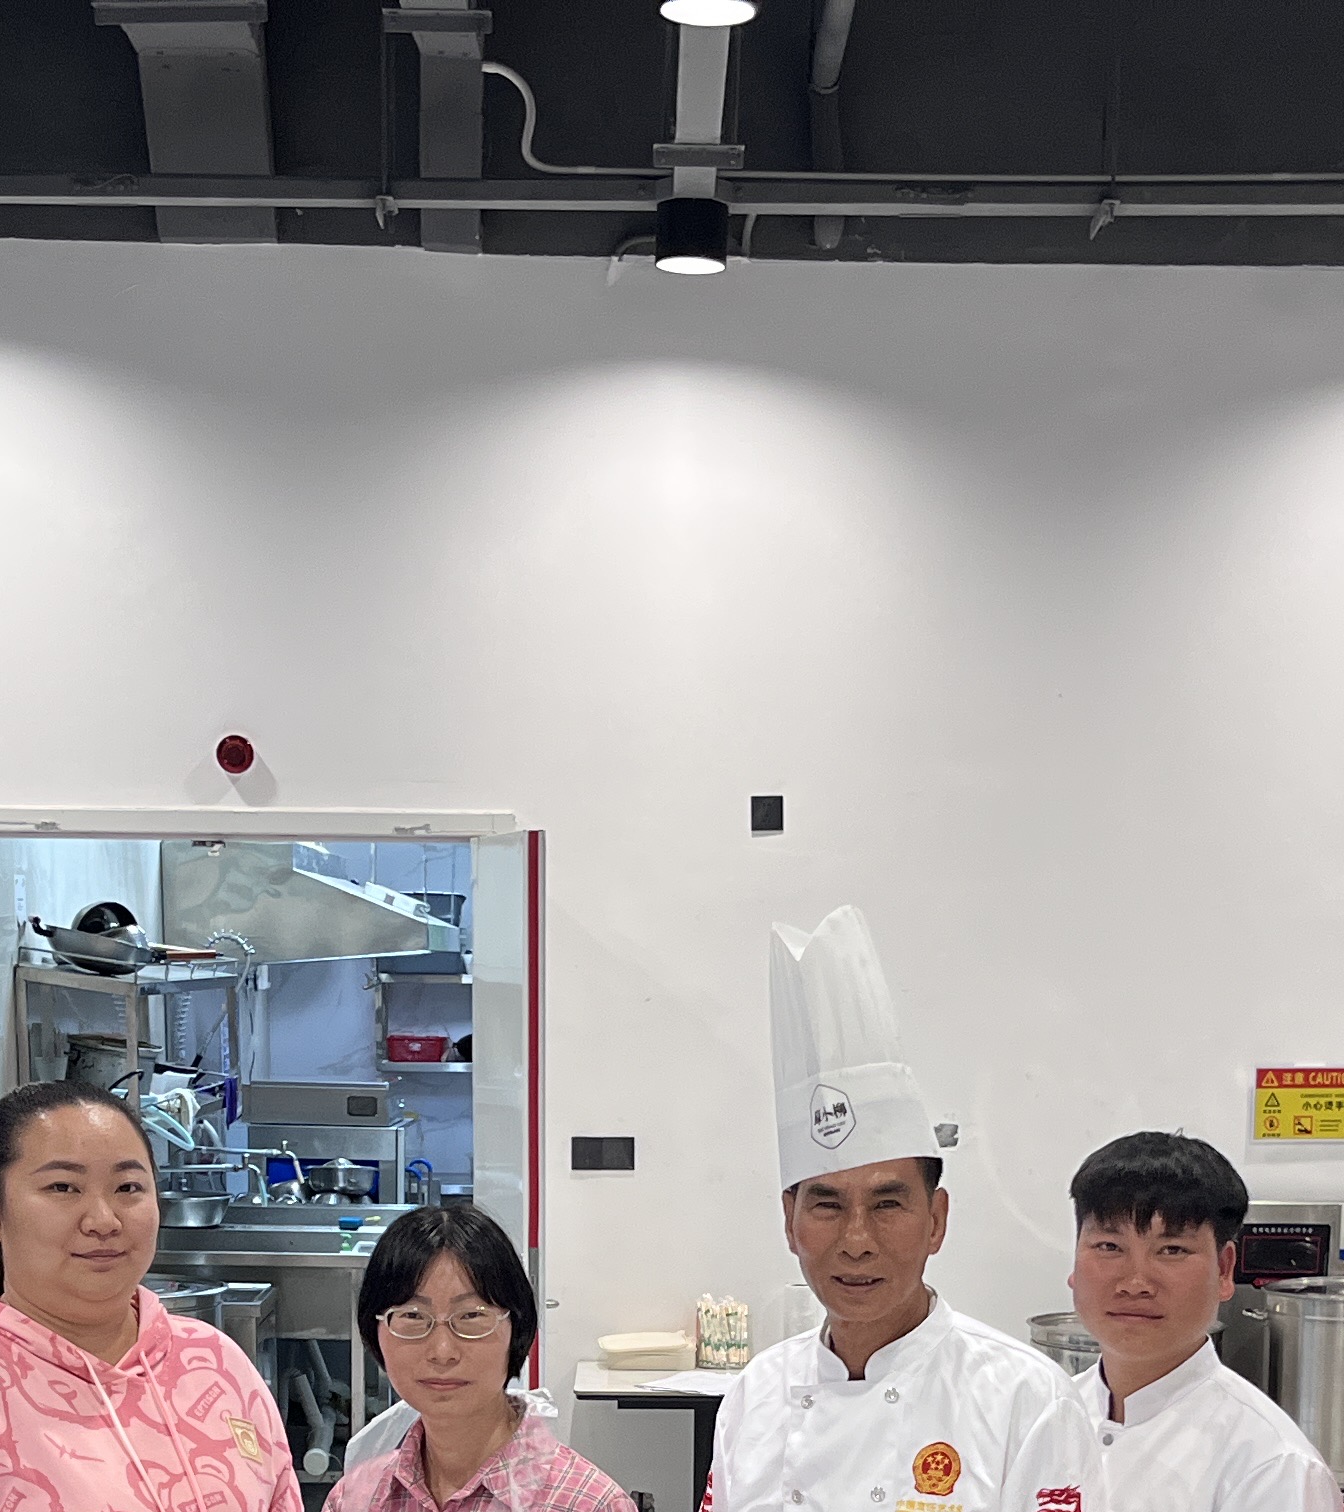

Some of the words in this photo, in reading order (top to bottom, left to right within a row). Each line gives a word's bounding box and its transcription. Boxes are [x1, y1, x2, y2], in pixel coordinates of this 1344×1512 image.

[1282, 1072, 1305, 1085] 注意
[1302, 1101, 1344, 1111] 小心烫手
